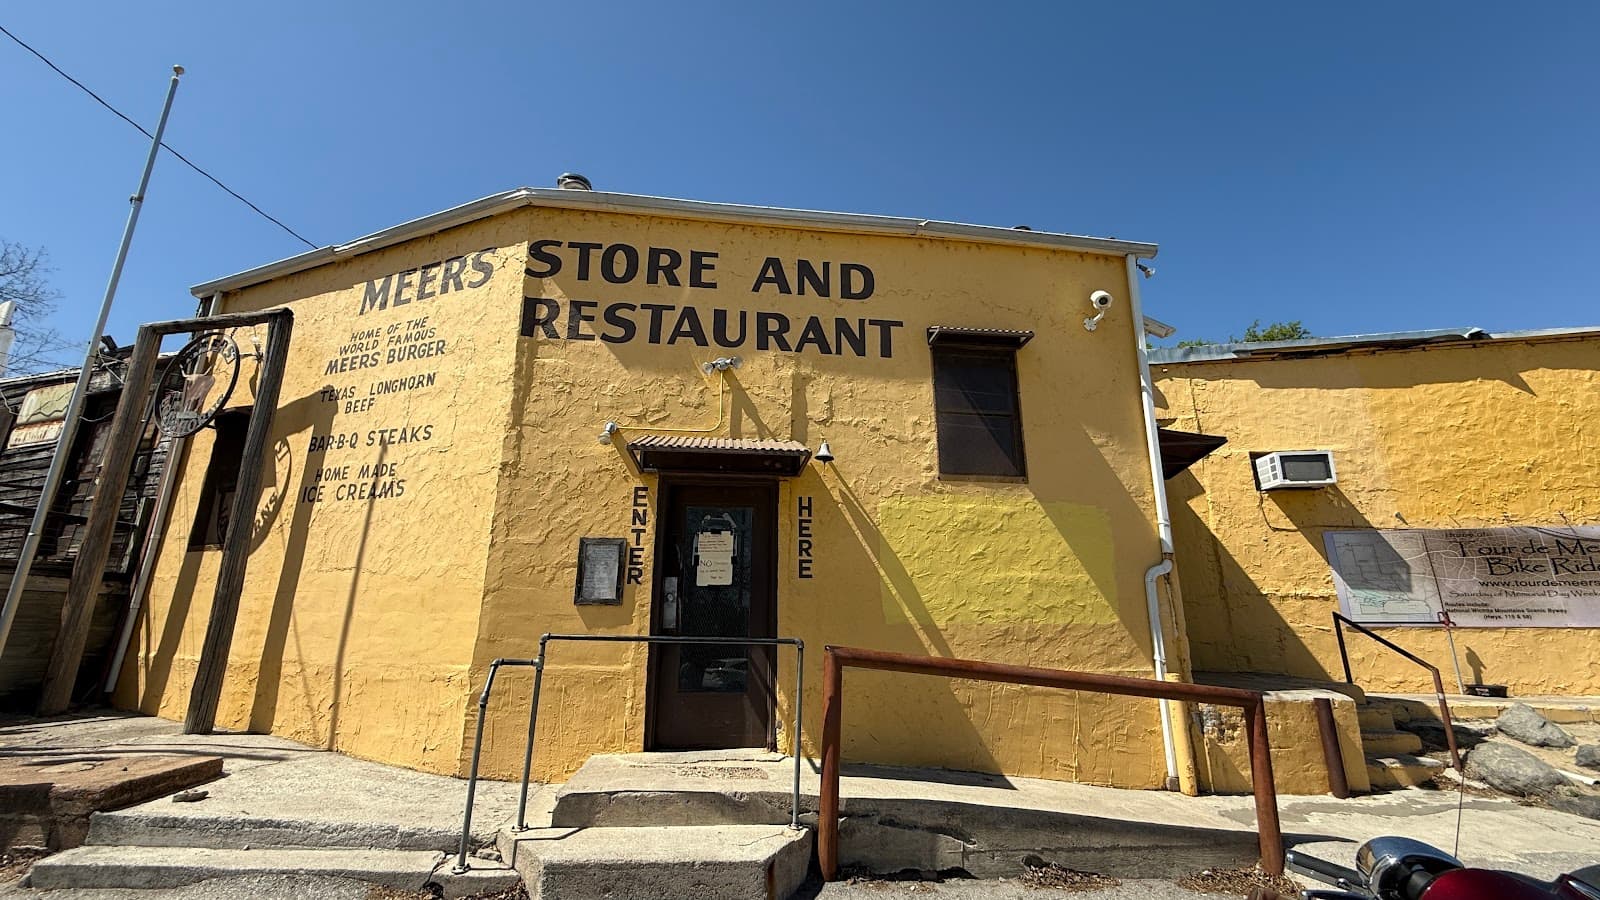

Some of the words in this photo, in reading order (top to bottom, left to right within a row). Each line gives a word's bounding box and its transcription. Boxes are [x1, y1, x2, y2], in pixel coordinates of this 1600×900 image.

[358, 248, 498, 315] MEERS
[525, 239, 720, 289] STORE
[751, 256, 877, 302] AND
[339, 339, 379, 355] WORLD
[387, 327, 436, 346] FAMOUS
[350, 327, 382, 342] HOME
[387, 322, 401, 335] OF
[405, 316, 429, 331] THE
[519, 295, 904, 359] RESTAURANT
[324, 352, 381, 376] MEERS
[386, 339, 446, 364] BURGER
[320, 386, 356, 402] TEXAS
[369, 372, 437, 396] LONGHORN
[344, 397, 375, 414] BEEF
[366, 424, 433, 447] STEAKS
[315, 465, 349, 482] HOME
[358, 462, 398, 478] MADE
[302, 486, 324, 503] ICE
[336, 480, 406, 501] CREAMS
[627, 487, 648, 585] ENTER
[798, 497, 812, 578] HERE
[1449, 540, 1516, 557] Tour
[1522, 539, 1550, 554] de
[1486, 557, 1547, 575] Bike
